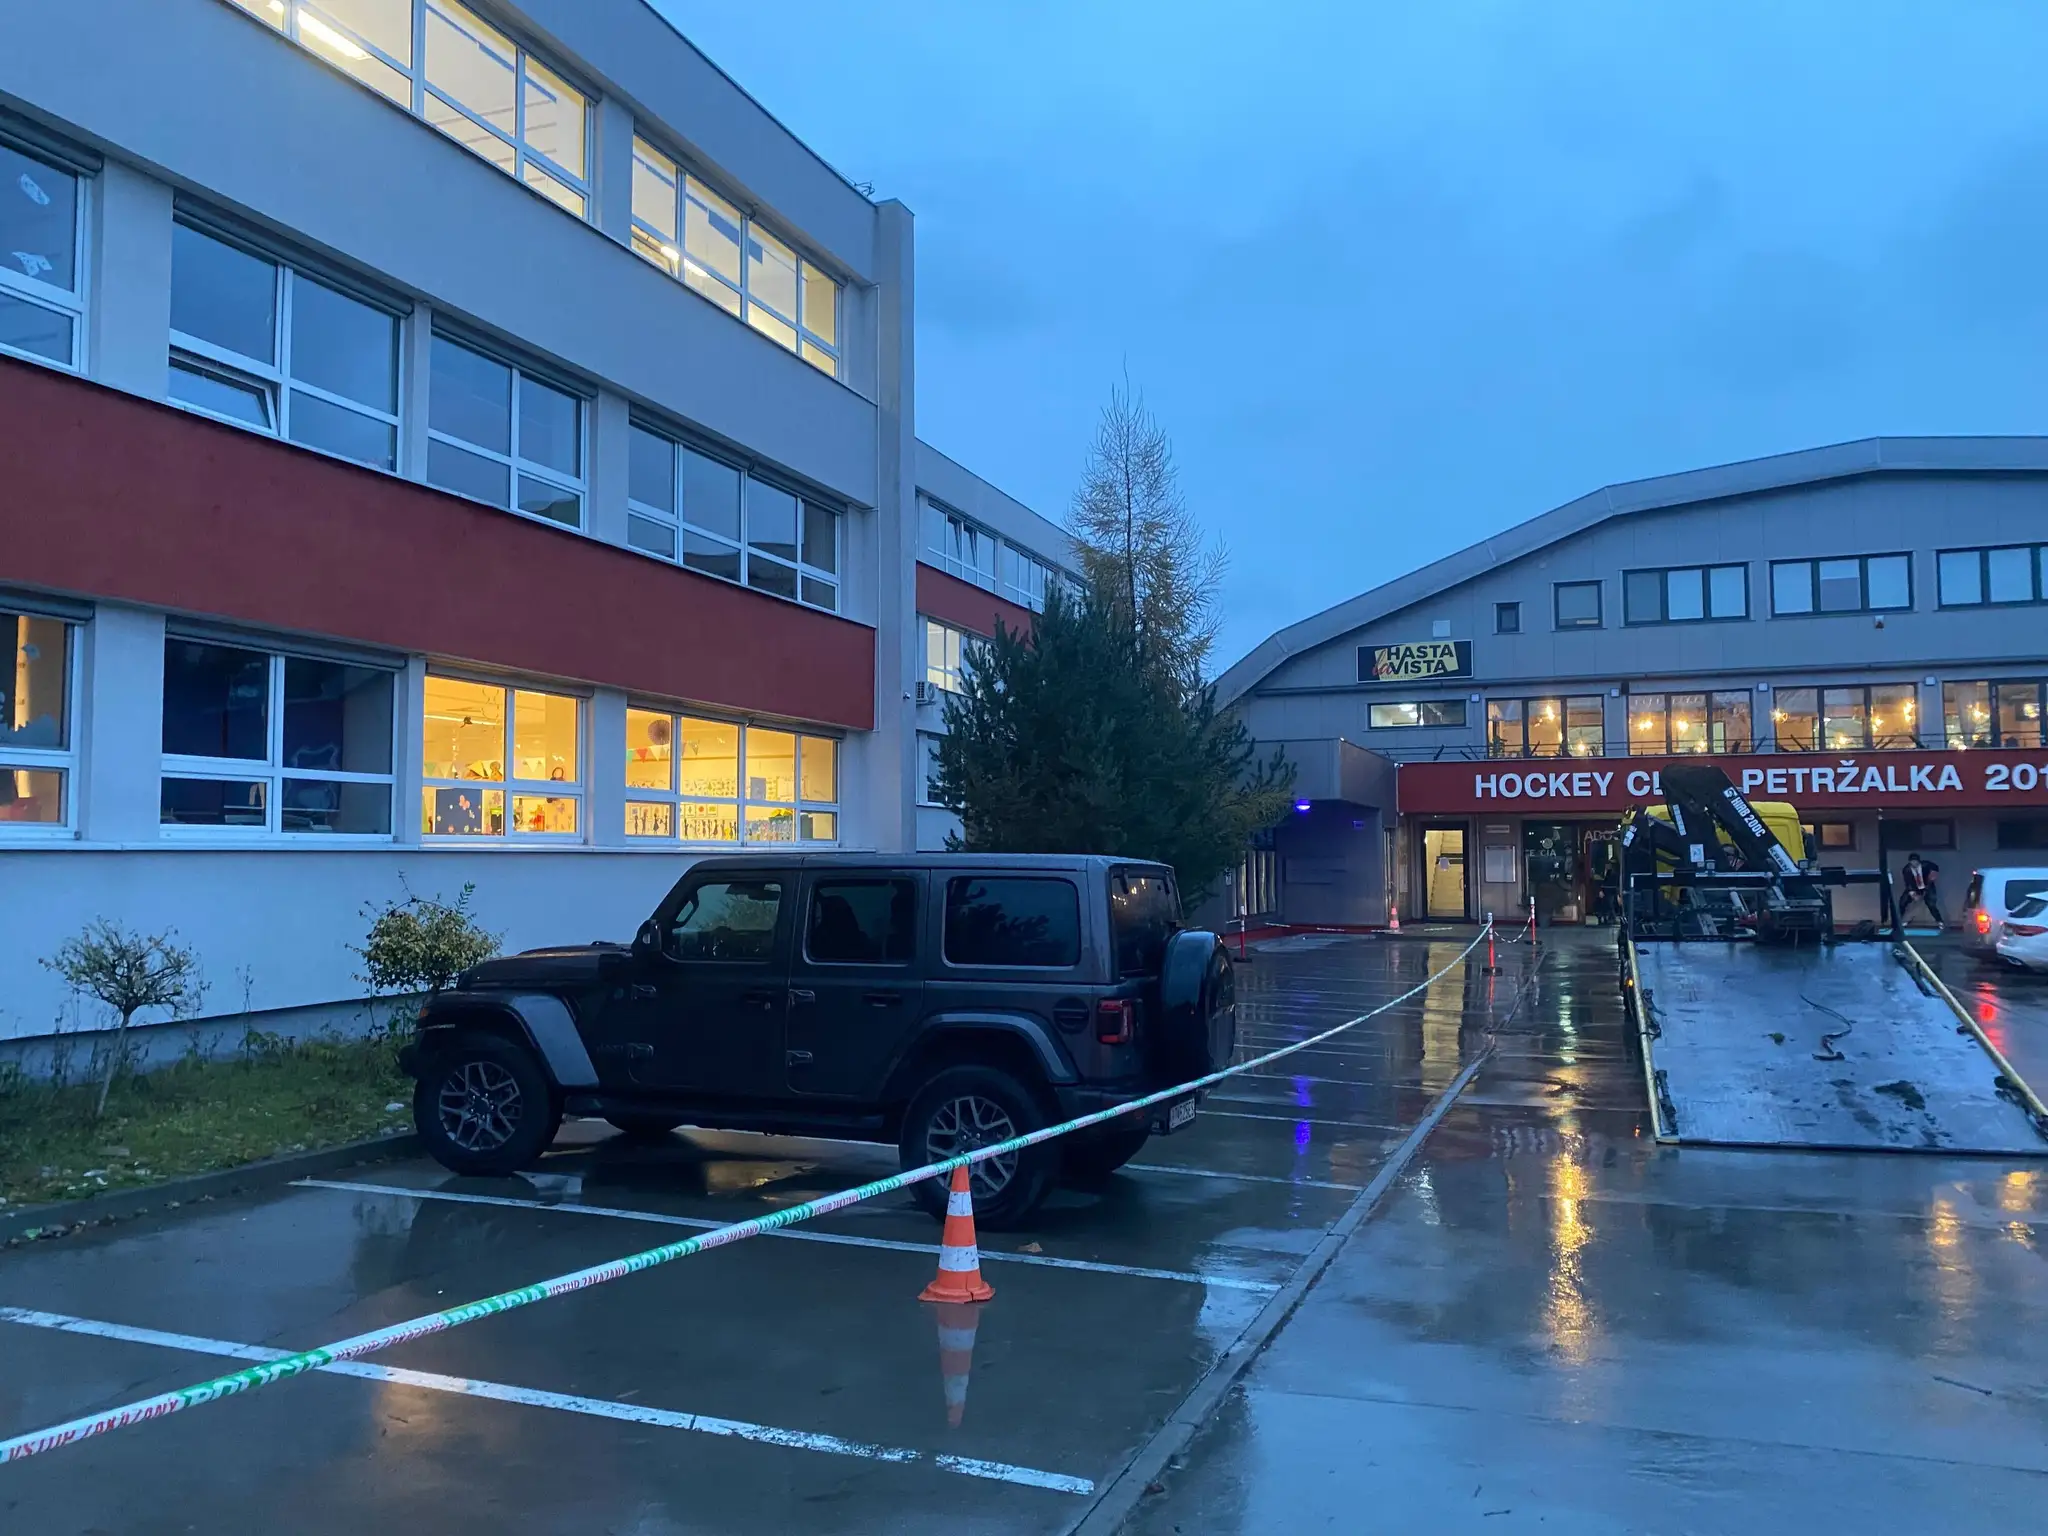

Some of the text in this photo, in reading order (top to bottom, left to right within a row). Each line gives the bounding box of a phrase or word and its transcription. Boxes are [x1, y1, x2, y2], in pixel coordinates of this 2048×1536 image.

[1387, 644, 1454, 661] HASTA
[1390, 659, 1448, 675] VISTA
[1475, 771, 1614, 798] HOCKEY
[1627, 770, 1664, 796] CL
[1742, 759, 1964, 794] PETRŽALKA
